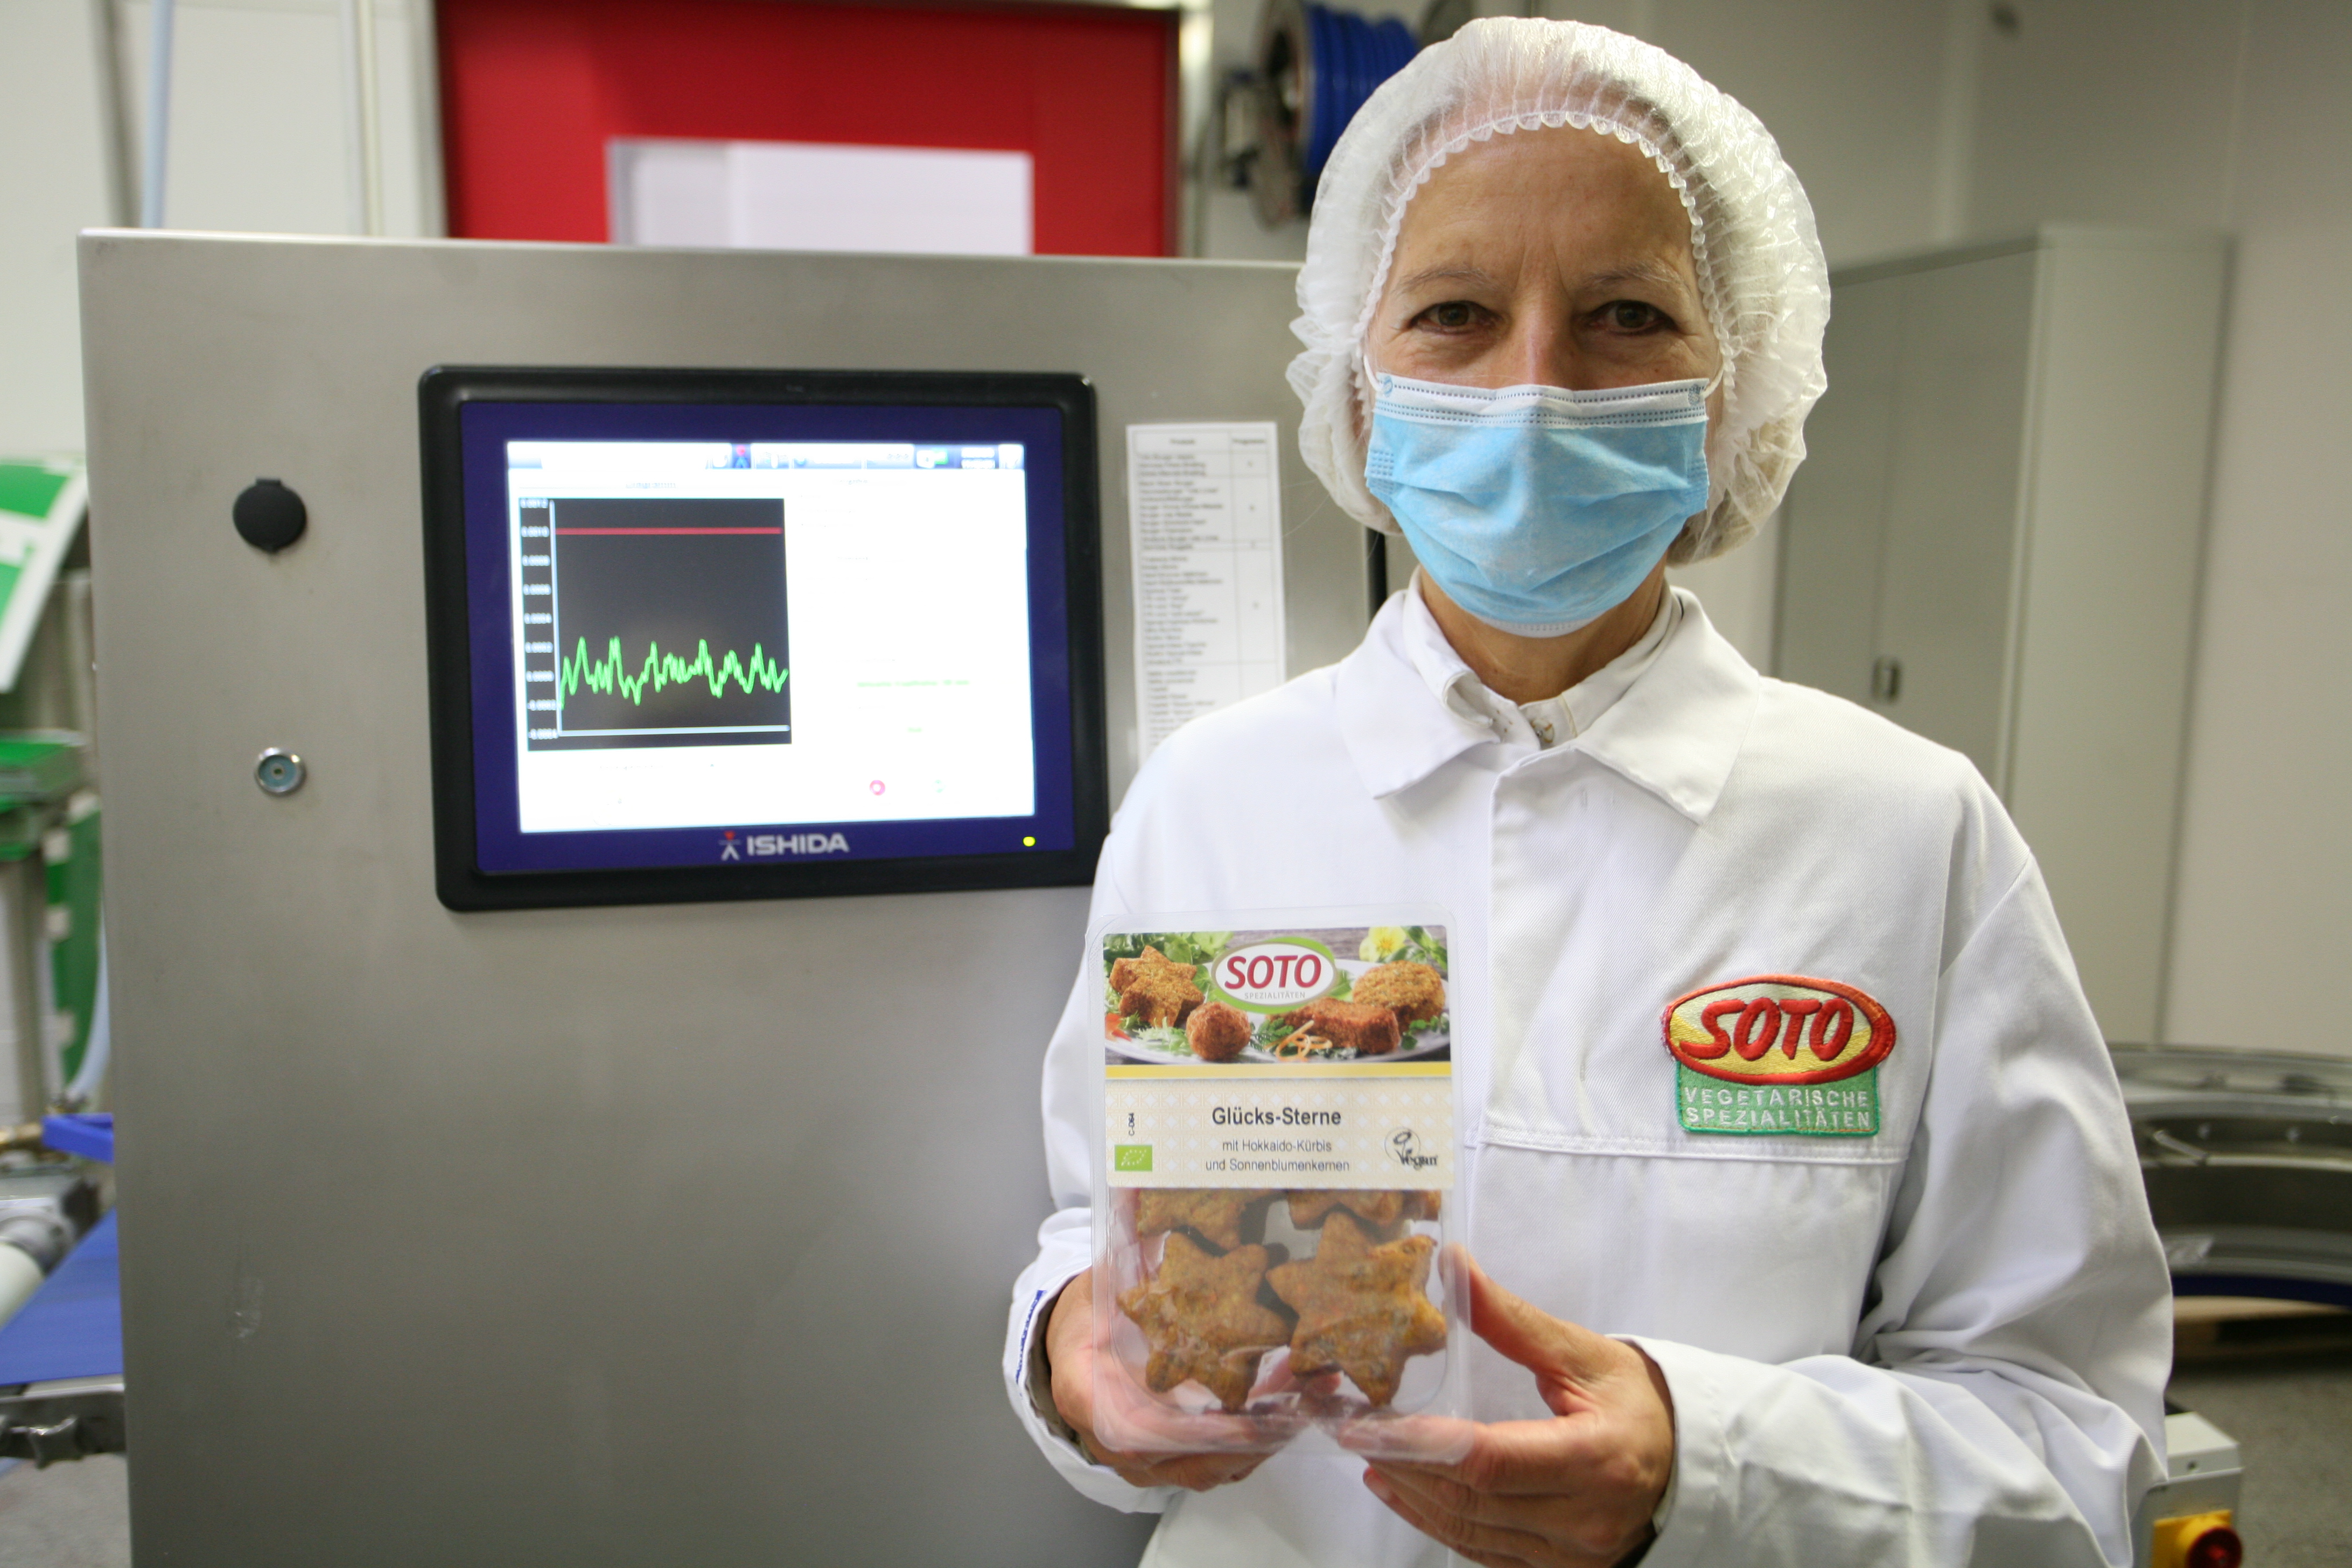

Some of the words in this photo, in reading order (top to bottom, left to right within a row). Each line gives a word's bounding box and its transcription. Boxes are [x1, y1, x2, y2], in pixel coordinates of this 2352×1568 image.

[746, 832, 850, 856] ISHIDA
[1224, 954, 1321, 990] SOTO
[1244, 991, 1306, 999] SPEZIALITÄTEN
[1679, 997, 1854, 1061] SOTO
[1684, 1087, 1870, 1107] VEGETARISCHE
[1212, 1107, 1342, 1125] Glücks-Sterne
[1685, 1107, 1871, 1128] SPEZIALITÄTEN
[1222, 1140, 1238, 1152] mit
[1242, 1139, 1332, 1152] Hokkaido-Kürbis
[1205, 1160, 1226, 1171] und
[1229, 1158, 1349, 1172] Sonnenblumenkernen
